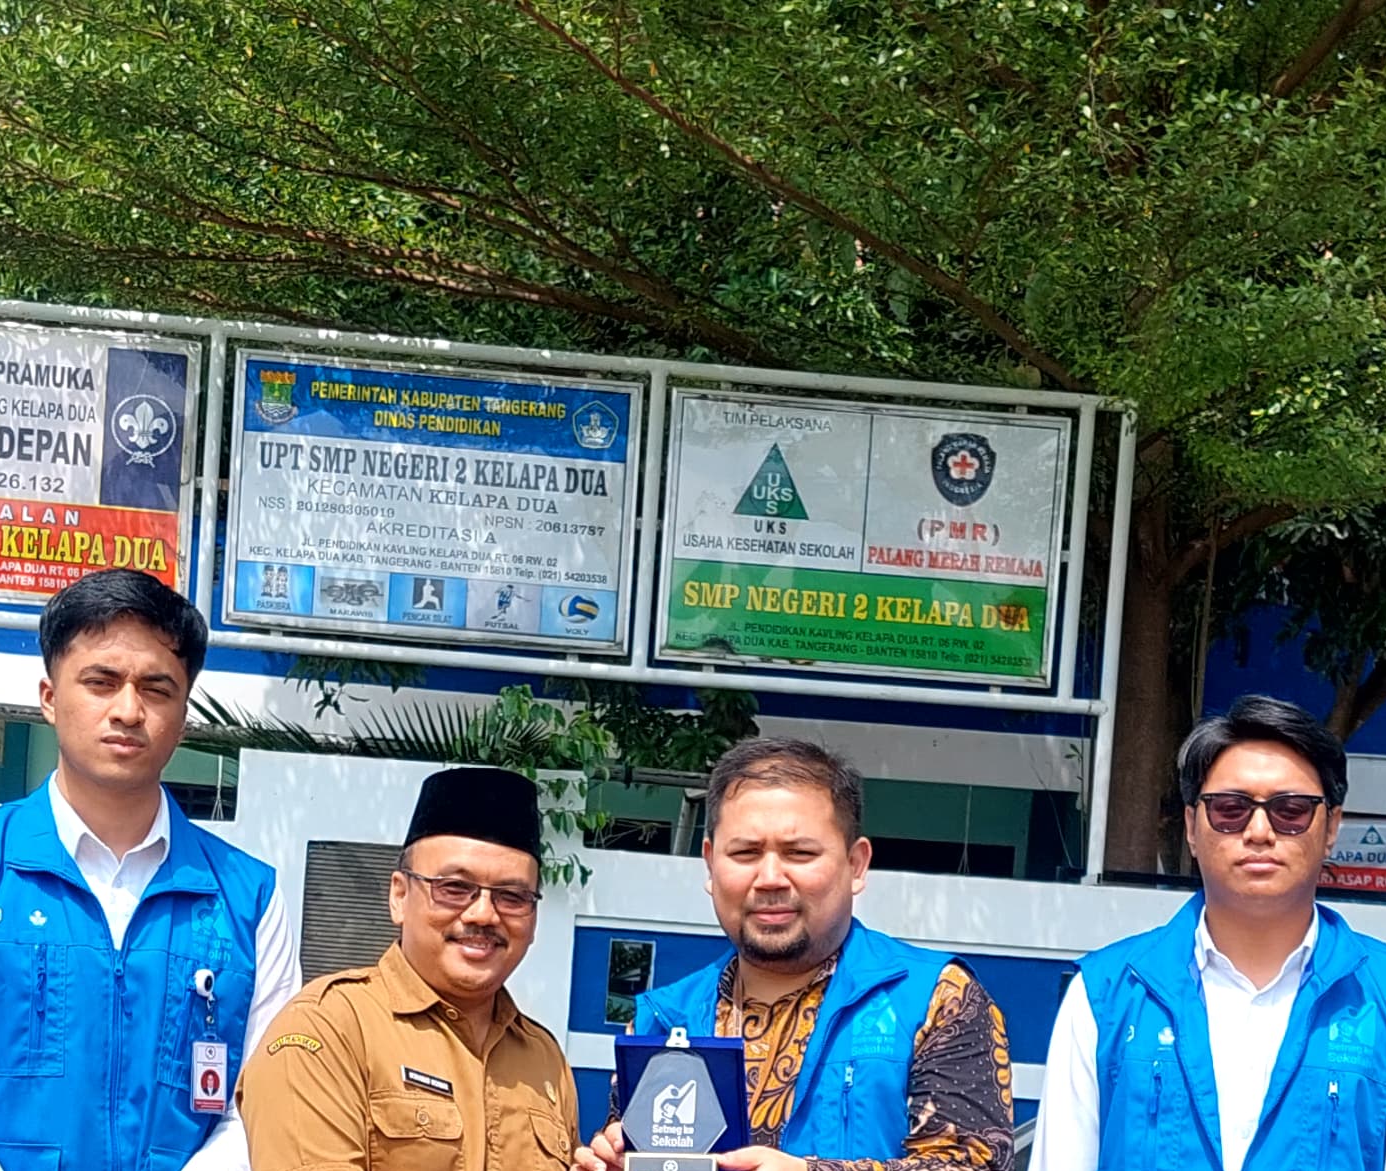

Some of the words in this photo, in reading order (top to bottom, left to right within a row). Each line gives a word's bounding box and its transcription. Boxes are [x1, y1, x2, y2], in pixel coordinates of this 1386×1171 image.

[11, 399, 64, 421] KELAPA
[67, 404, 97, 423] DUA
[311, 381, 397, 405] PEMERINTAH
[400, 389, 481, 412] KABUPATEN
[483, 396, 567, 419] TANGERANG
[373, 410, 415, 428] DINAS
[419, 415, 501, 437] PENDIDIKAN
[723, 411, 746, 425] TIM
[750, 414, 833, 432] PELAKSANA
[259, 441, 304, 471] UPT
[308, 444, 357, 475] SMP
[361, 450, 450, 483] NEGERI
[454, 457, 467, 484] 2
[473, 459, 560, 493] KELAPA
[564, 467, 608, 497] DUA
[258, 496, 286, 510] NSS
[307, 478, 422, 503] KECAMATAN
[428, 489, 510, 510] KELAPA
[516, 496, 558, 514] DUA
[365, 522, 479, 543] AKREDITASI
[484, 532, 497, 544] A
[484, 515, 524, 530] NPSN
[0, 525, 107, 567] KELAPA
[112, 535, 167, 571] DUA
[249, 545, 273, 557] KEC.
[276, 548, 315, 560] KELAPA
[318, 551, 340, 562] DUA
[369, 556, 432, 569] TANGERANG
[440, 561, 481, 574] BANTEN
[318, 538, 381, 553] PENDIDIKAN
[382, 543, 427, 557] KAVLING
[429, 547, 470, 561] KELAPA
[471, 550, 492, 561] DUA
[546, 557, 558, 567] 02
[683, 534, 724, 550] USAHA
[727, 537, 796, 556] KESEHATAN
[799, 542, 855, 560] SEKOLAH
[24, 563, 47, 574] DUA
[867, 546, 925, 568] PALANG
[928, 551, 982, 574] MERAH
[984, 555, 1044, 578] REMAJA
[684, 580, 740, 609] SMP
[745, 585, 847, 618] NEGERI
[852, 592, 869, 621] 2
[875, 595, 975, 629] KELAPA
[980, 604, 1031, 633] DUA
[1337, 873, 1373, 886] ASAP
[651, 1134, 694, 1148] Sekolah
